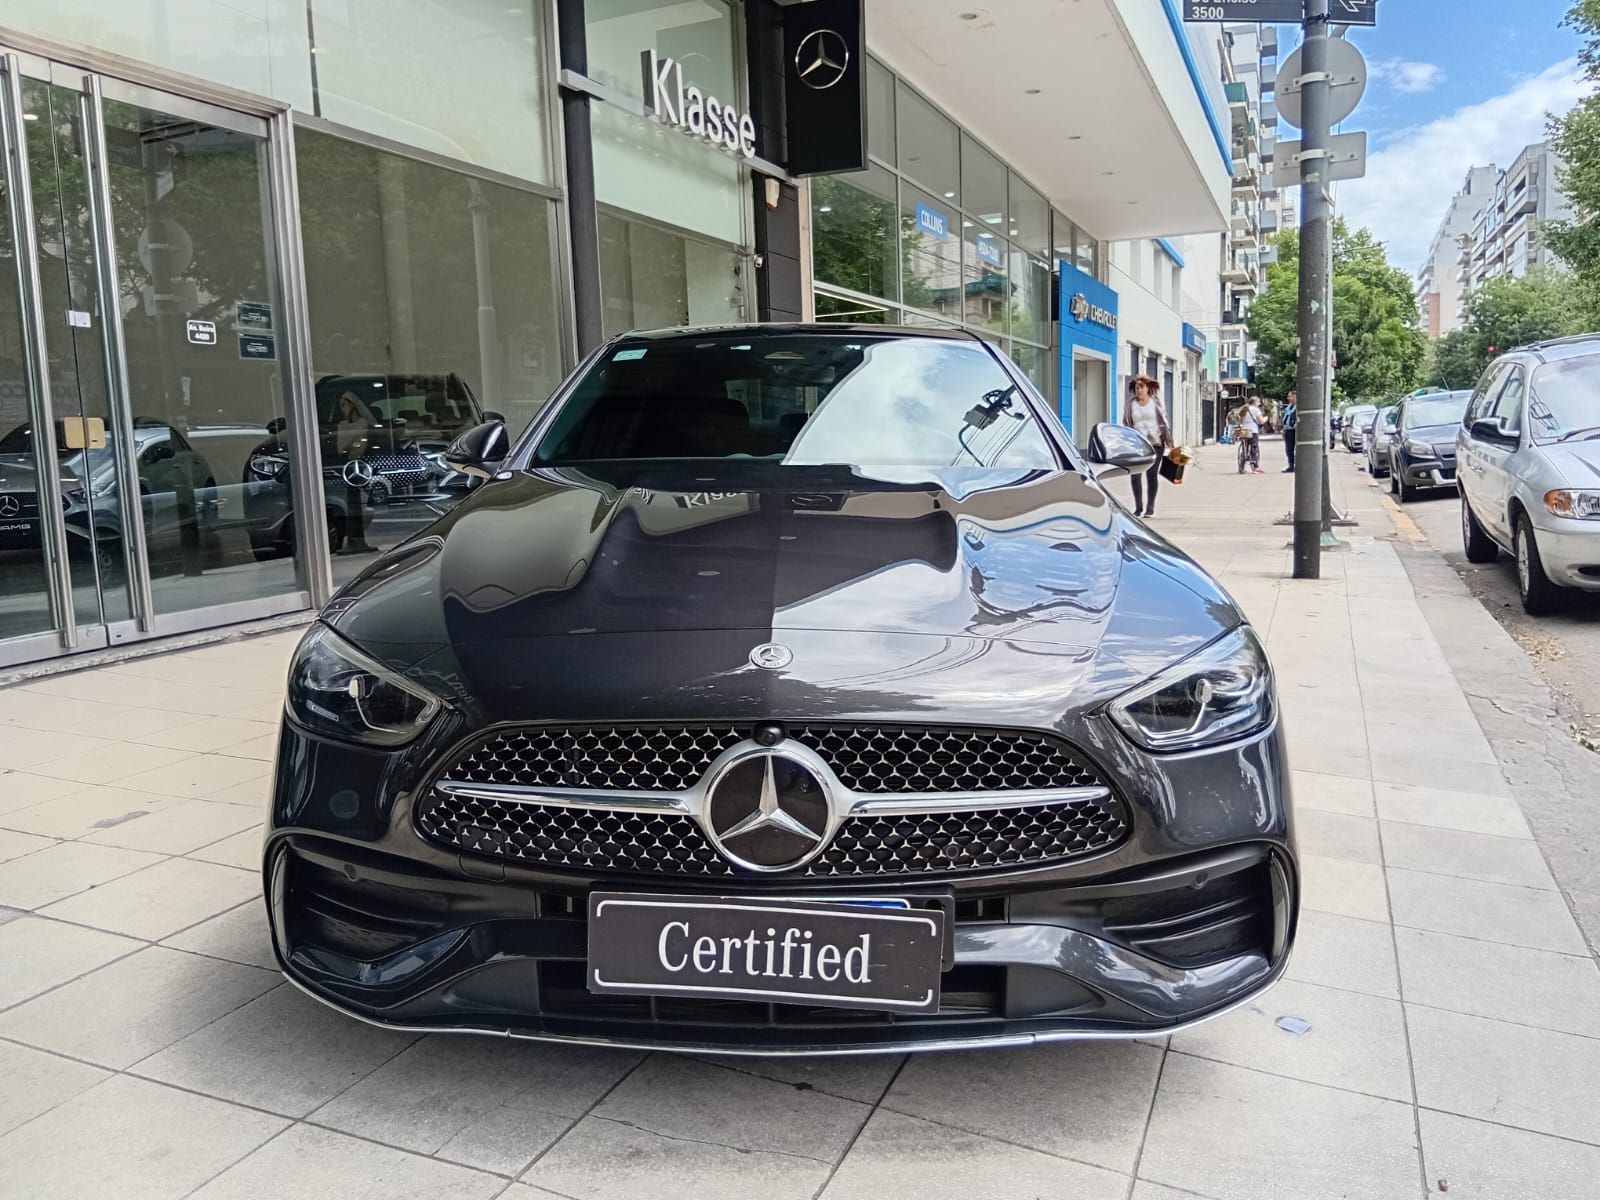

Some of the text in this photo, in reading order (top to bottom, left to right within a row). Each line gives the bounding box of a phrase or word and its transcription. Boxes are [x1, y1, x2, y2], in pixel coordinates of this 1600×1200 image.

[1192, 6, 1225, 20] 3500
[641, 48, 757, 159] Klasse
[920, 209, 944, 235] COLLINS
[658, 920, 872, 985] Certified
